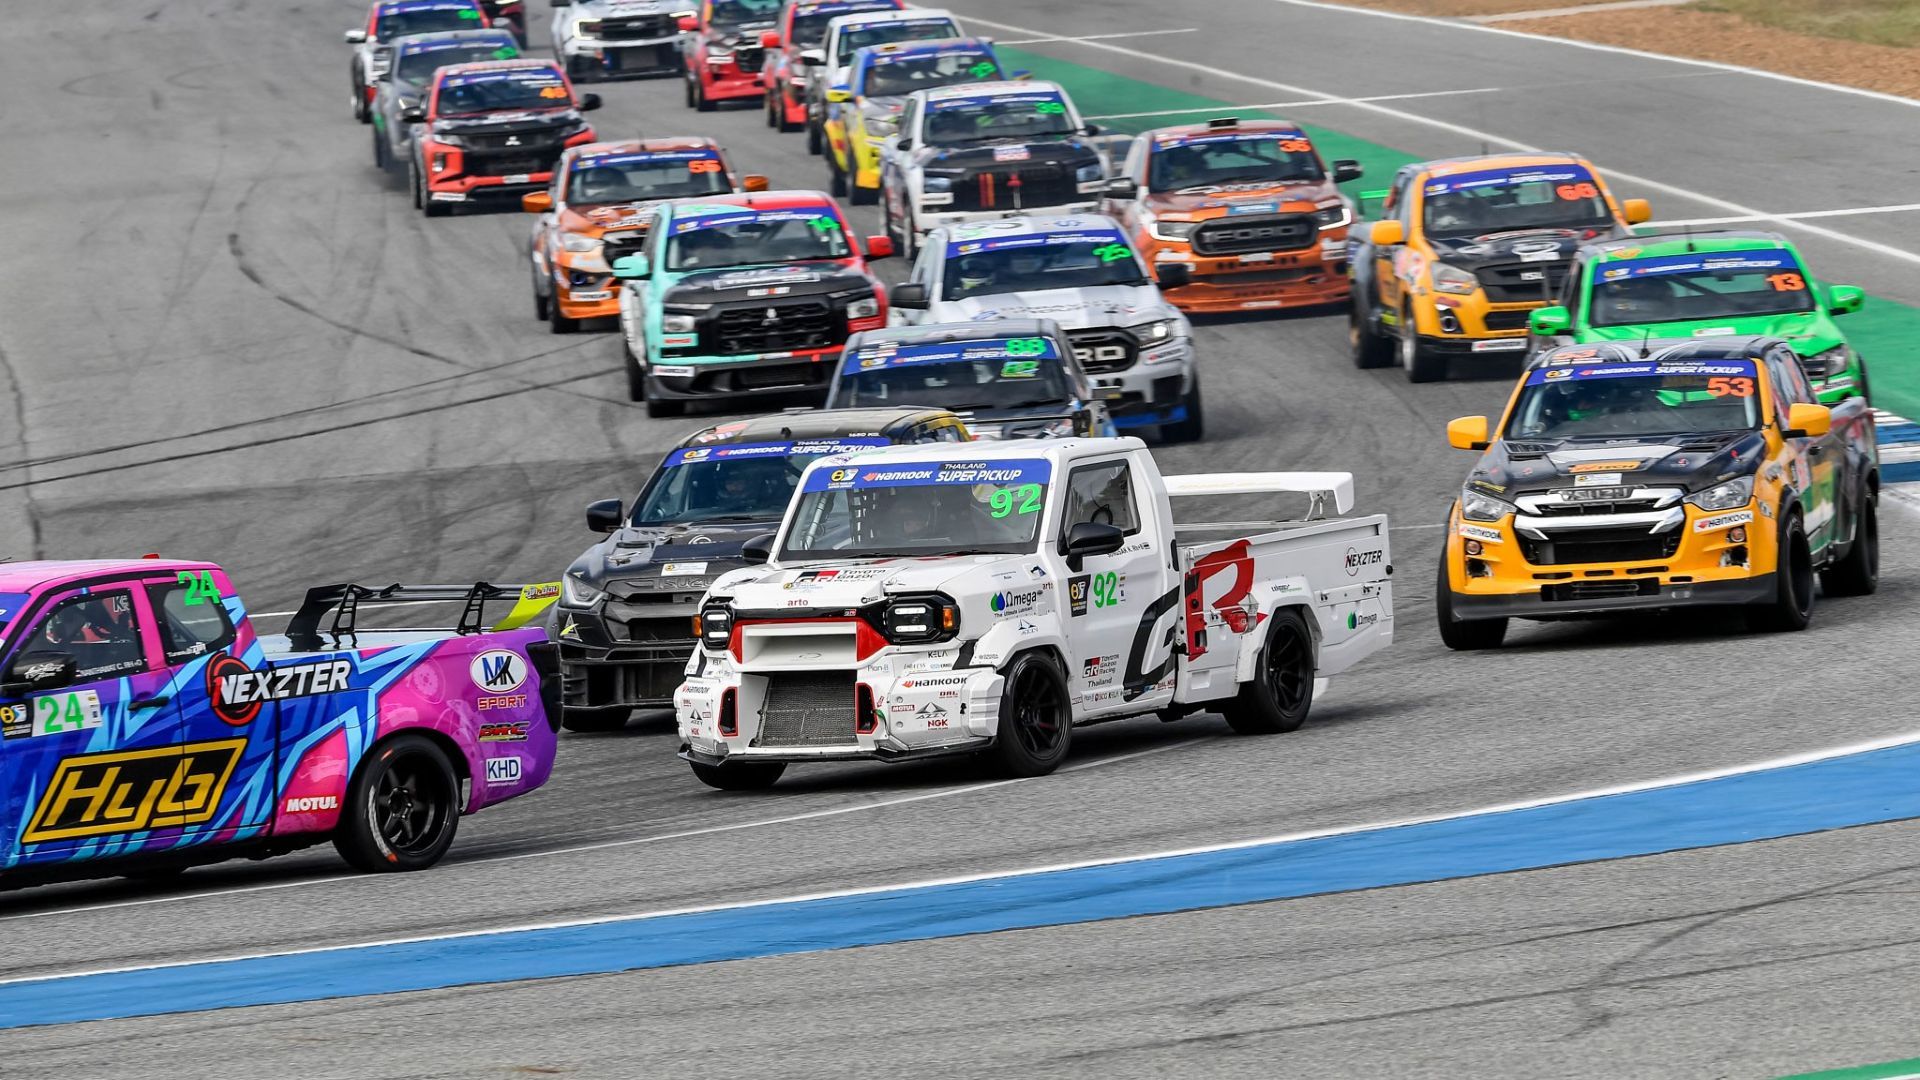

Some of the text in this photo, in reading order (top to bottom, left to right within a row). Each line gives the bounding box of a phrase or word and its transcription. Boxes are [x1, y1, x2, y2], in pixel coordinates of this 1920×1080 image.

[1765, 273, 1805, 292] 13
[1073, 346, 1127, 362] RD
[1707, 377, 1754, 397] 53
[789, 445, 831, 454] SUPER
[936, 469, 1022, 482] SUPER PICKUP
[944, 463, 987, 471] THAILAND
[990, 484, 1042, 519] 92
[1345, 550, 1382, 568] NEXZTER
[178, 571, 220, 606] 24
[1093, 571, 1118, 608] 92
[211, 661, 350, 706] NEXZTER
[1088, 677, 1112, 687] Thailand
[478, 695, 527, 710] SPORT
[39, 693, 84, 733] 24
[928, 719, 948, 727] NGK
[487, 759, 519, 779] KHD
[286, 797, 338, 812] MOTUL
